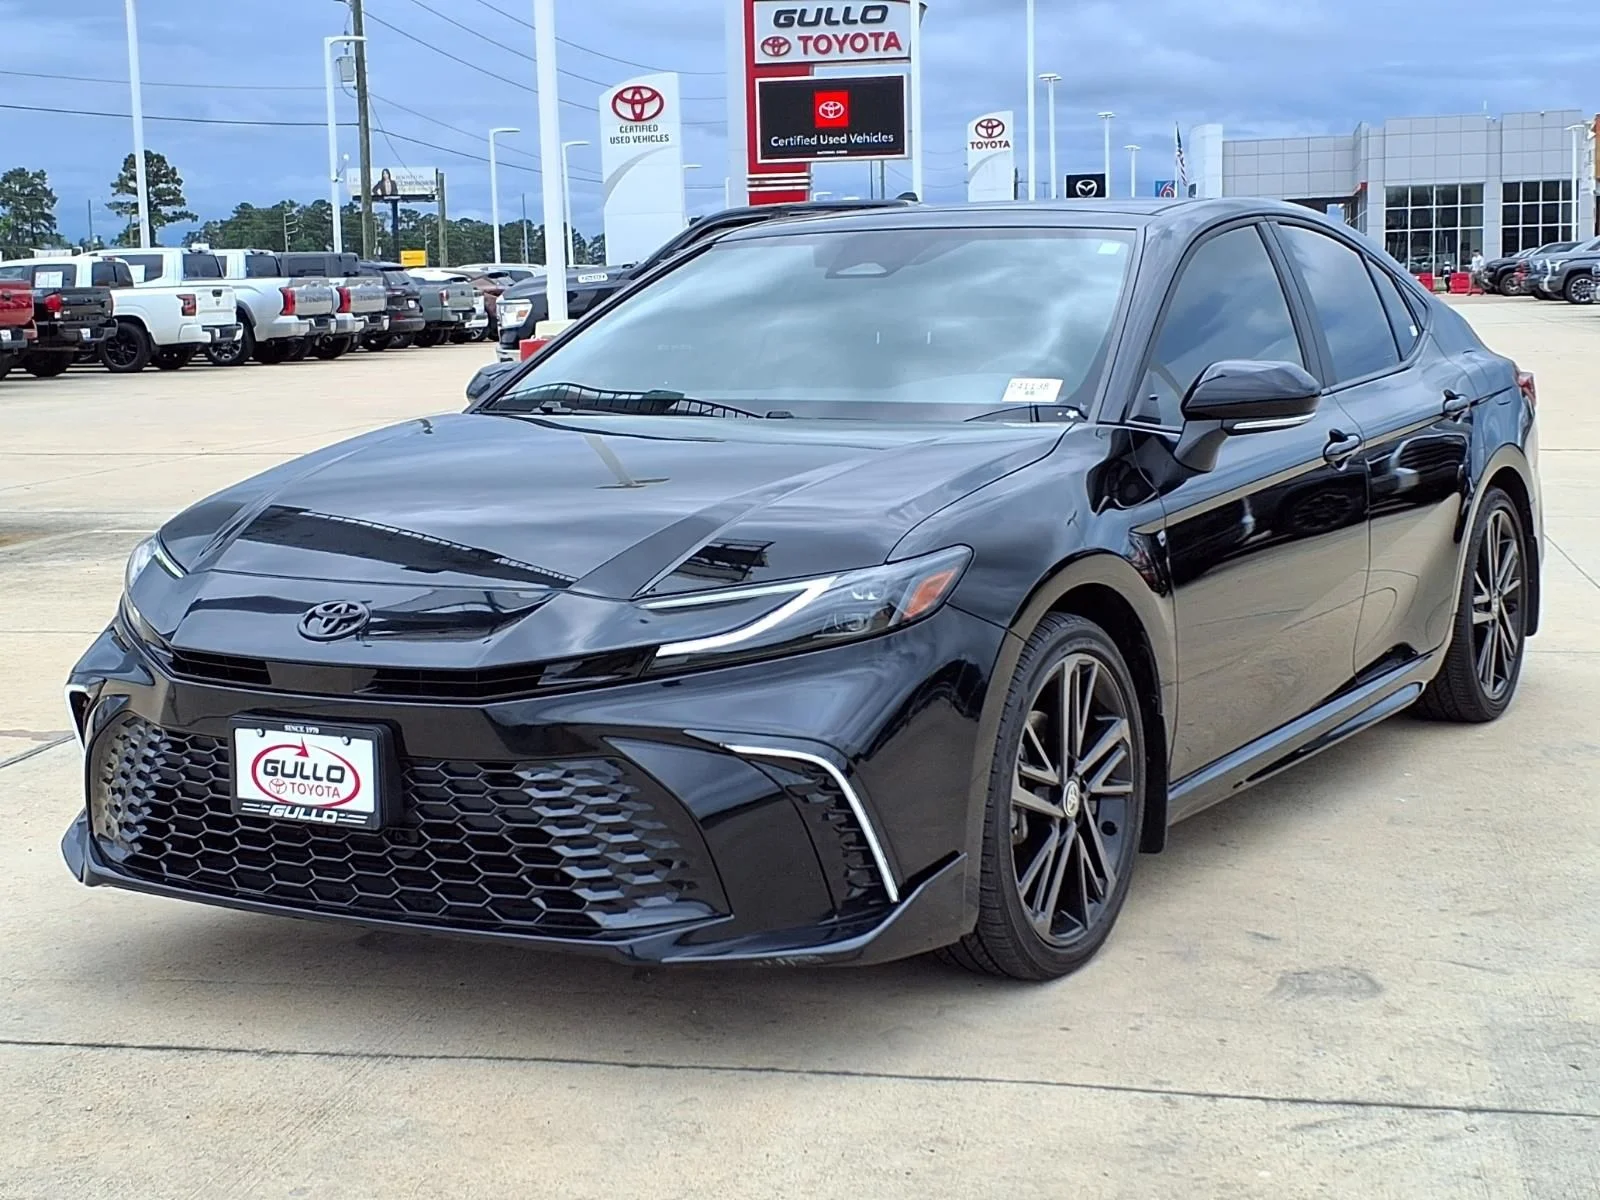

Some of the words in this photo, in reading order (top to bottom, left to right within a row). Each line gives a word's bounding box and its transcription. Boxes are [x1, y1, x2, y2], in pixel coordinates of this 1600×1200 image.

[772, 4, 888, 28] GULLO
[797, 31, 902, 55] TOYOTA
[619, 124, 659, 133] CERTIFIED
[609, 136, 631, 144] USED
[632, 134, 670, 144] VEHICLES
[770, 134, 817, 147] Certified
[819, 133, 847, 144] Used
[849, 131, 894, 144] Vehicles
[969, 139, 1011, 150] TOYOTA
[284, 724, 304, 733] SINCE
[263, 758, 345, 783] GULLO
[289, 782, 341, 799] TOYOTA
[268, 804, 338, 824] GULLO
